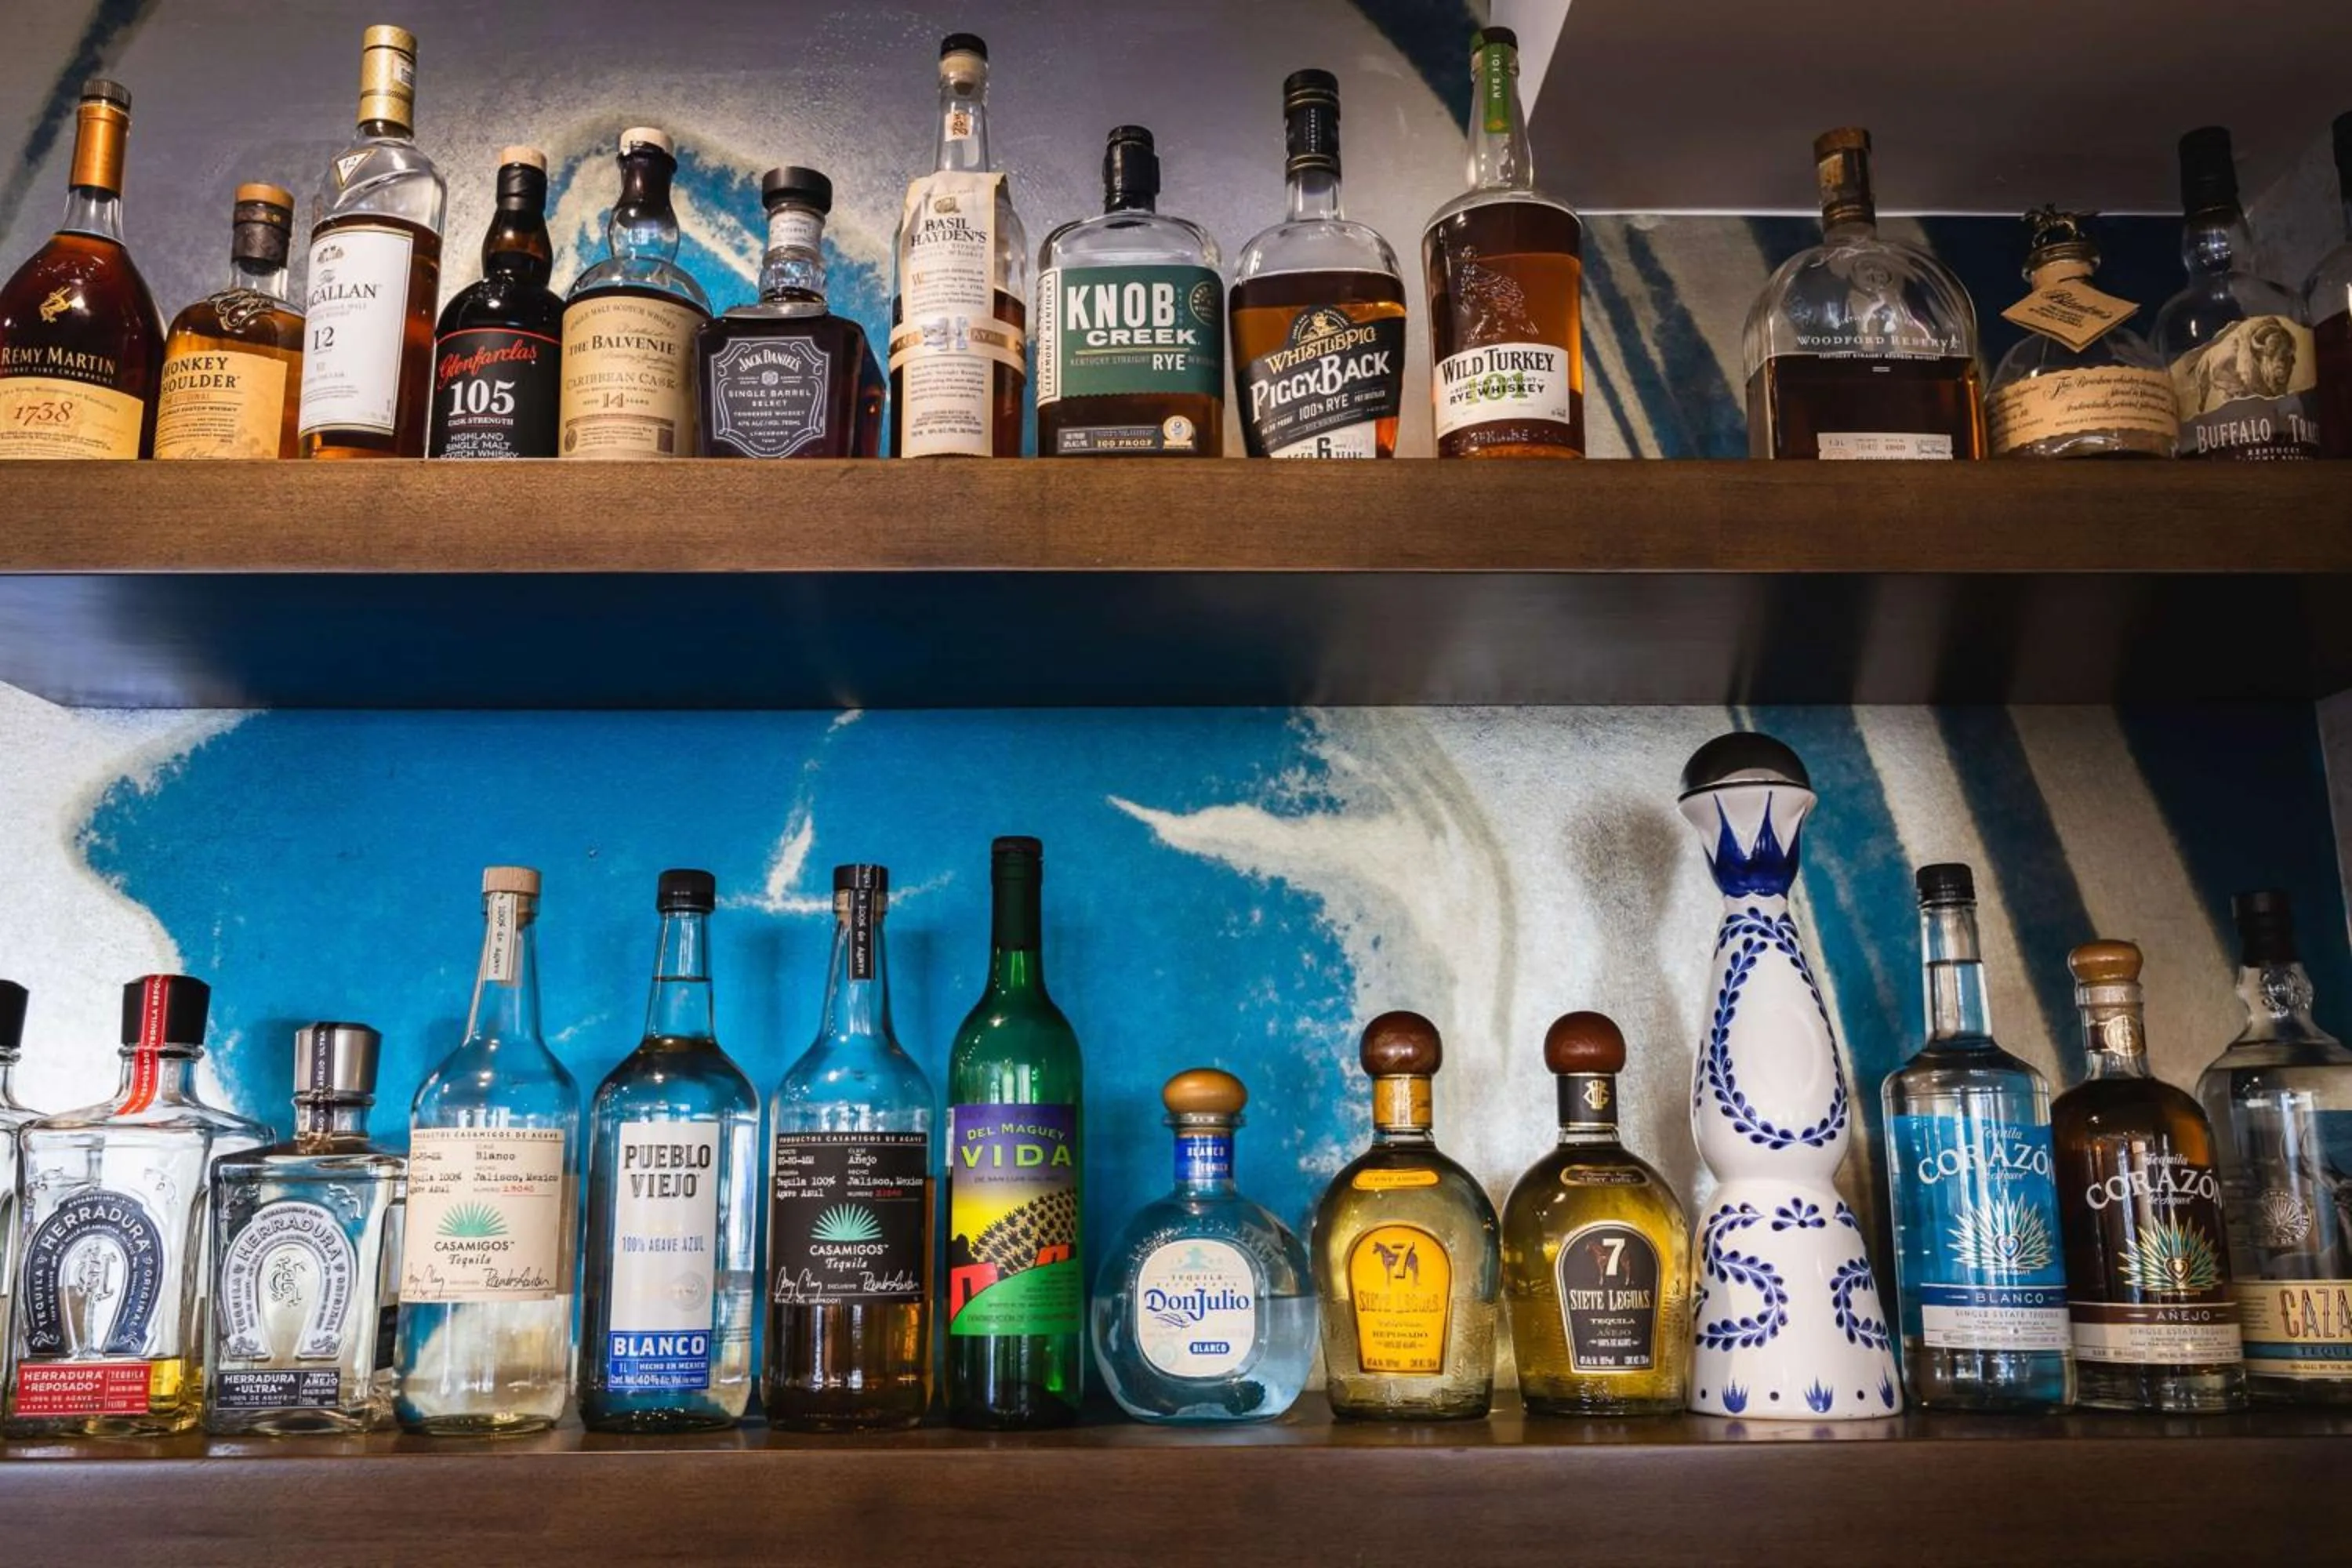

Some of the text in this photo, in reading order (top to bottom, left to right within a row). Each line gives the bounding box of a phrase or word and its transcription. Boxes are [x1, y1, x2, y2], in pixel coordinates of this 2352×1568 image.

[925, 216, 971, 232] BASIL
[911, 230, 987, 248] HAYDEN'S
[306, 284, 377, 311] ACALLAN
[1067, 283, 1174, 330] KNOB
[314, 326, 334, 351] 12
[570, 335, 677, 356] THE BALVENIE
[1087, 329, 1197, 345] CREEK
[1798, 334, 1959, 350] WOODFORD RESERVE
[1265, 326, 1377, 375] WHISTLEPIG
[47, 346, 116, 376] MARTIN
[164, 358, 228, 377] MONKEY
[738, 349, 802, 373] JACK DANIEL'S
[1153, 354, 1185, 371] RYE
[1442, 347, 1555, 385] WILD TURKEY
[162, 374, 237, 394] HOULDER
[1250, 351, 1390, 424] PIGGYBACK
[1465, 372, 1528, 405] 101
[448, 379, 516, 416] 105
[603, 393, 624, 408] 14
[728, 389, 811, 398] SINGLE BARREL
[1450, 383, 1544, 405] RYE WHISKEY
[1326, 394, 1349, 412] RYE
[14, 401, 73, 426] 1738
[467, 416, 514, 426] STRENGTH
[451, 432, 504, 441] HIGHLAND
[2197, 418, 2271, 454] BUFFALO
[445, 441, 511, 452] SINGLE MALT
[1316, 437, 1332, 459] 6
[149, 1008, 159, 1046] TEQUILA
[967, 1123, 1065, 1141] DEL MAGUEY
[475, 1152, 516, 1162] Blanco
[624, 1144, 711, 1169] PUEBLO
[848, 1153, 877, 1166] Añejo
[961, 1145, 1072, 1168] VIDA
[439, 1172, 463, 1183] 100%
[630, 1174, 697, 1198] VIEJO
[777, 1176, 837, 1188] Tequila 100%
[847, 1177, 893, 1187] Jalisco,
[41, 1205, 151, 1252] HERRADURA
[237, 1214, 342, 1261] HERRADURA
[434, 1241, 510, 1252] CASAMIGOS
[622, 1236, 705, 1253] 100% AGAVE AZUL
[809, 1244, 884, 1255] CASAMIGOS
[448, 1254, 492, 1268] Tequila
[825, 1257, 868, 1272] Tequila
[1602, 1238, 1625, 1276] 7
[34, 1269, 48, 1327] TEQUILA
[131, 1269, 153, 1332] ORIGINAL
[1570, 1289, 1651, 1311] SIETE LEGUAS
[1975, 1294, 2045, 1304] BLANCO
[2157, 1306, 2211, 1321] AÑEJO
[614, 1336, 706, 1356] BLANCO
[1192, 1343, 1227, 1352] BLANCO
[24, 1370, 103, 1381] HERRADURA
[224, 1374, 296, 1384] HERRADURA
[303, 1377, 338, 1387] AÑEJO
[31, 1382, 93, 1392] REPOSADO
[241, 1385, 277, 1393] ULTRA
